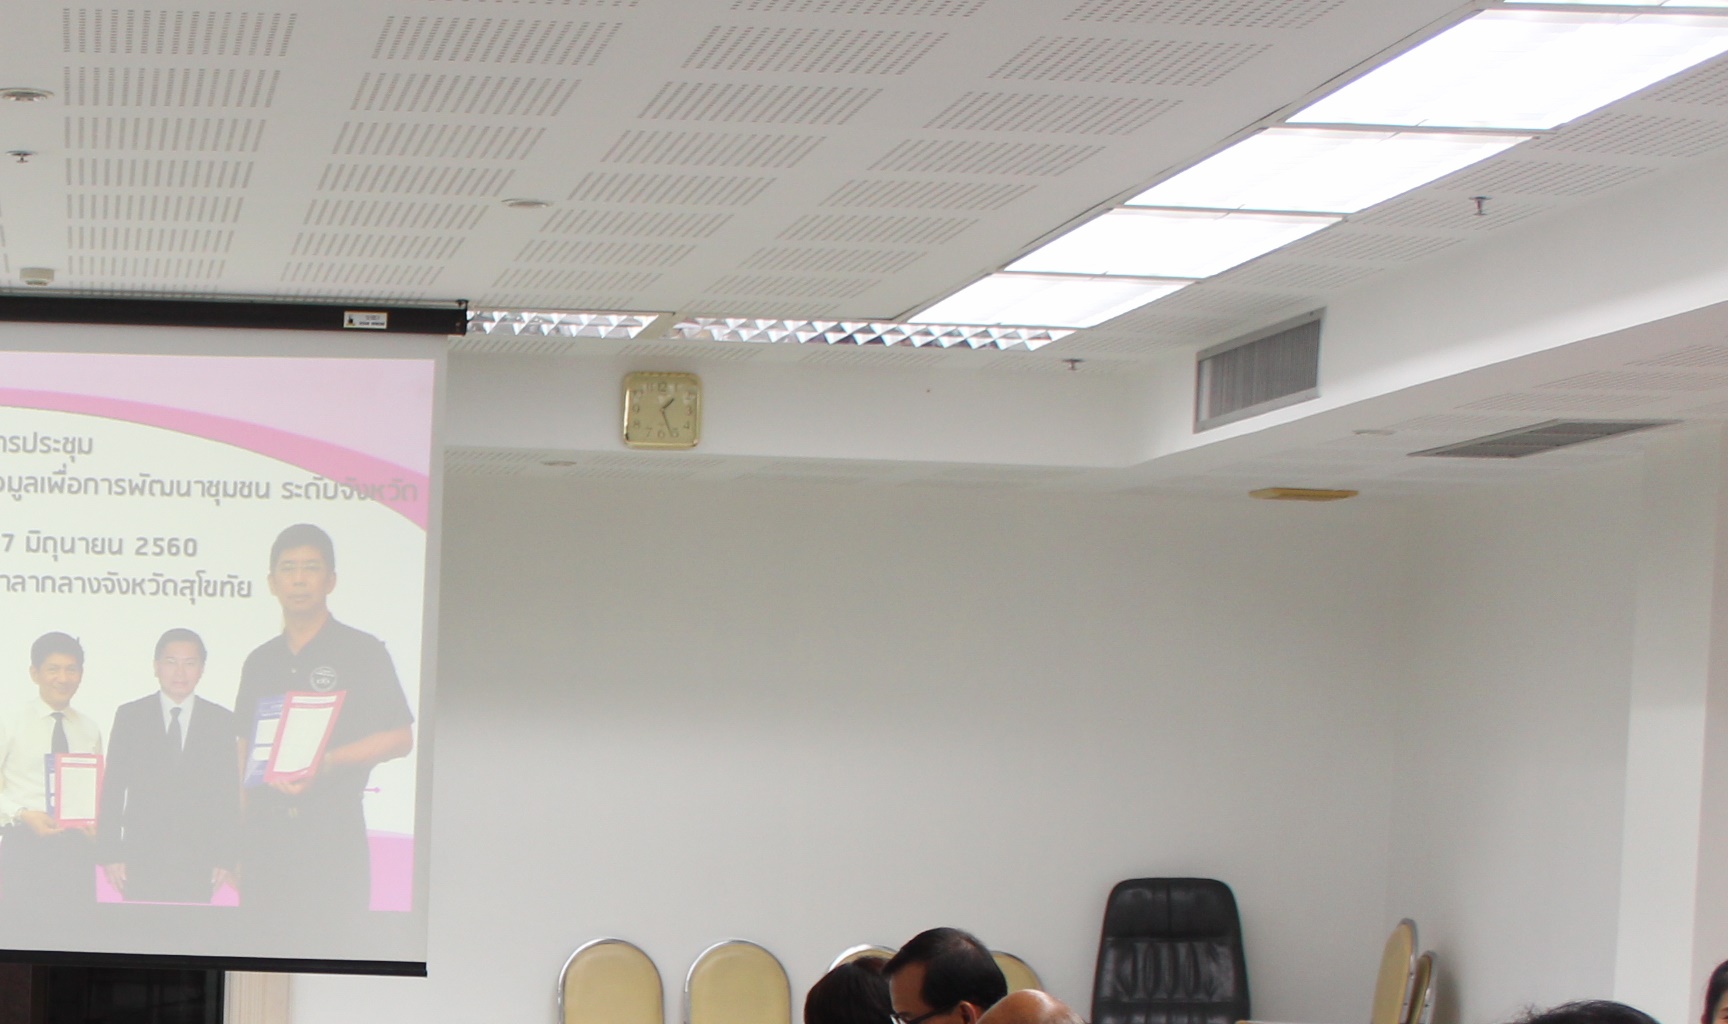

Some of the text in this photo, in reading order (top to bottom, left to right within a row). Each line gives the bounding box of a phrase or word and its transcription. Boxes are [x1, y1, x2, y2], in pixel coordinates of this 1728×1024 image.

[657, 381, 667, 392] 12
[281, 475, 419, 501] ระดับจังหวัด
[26, 530, 124, 562] มิถุนายน
[135, 537, 198, 557] 2560
